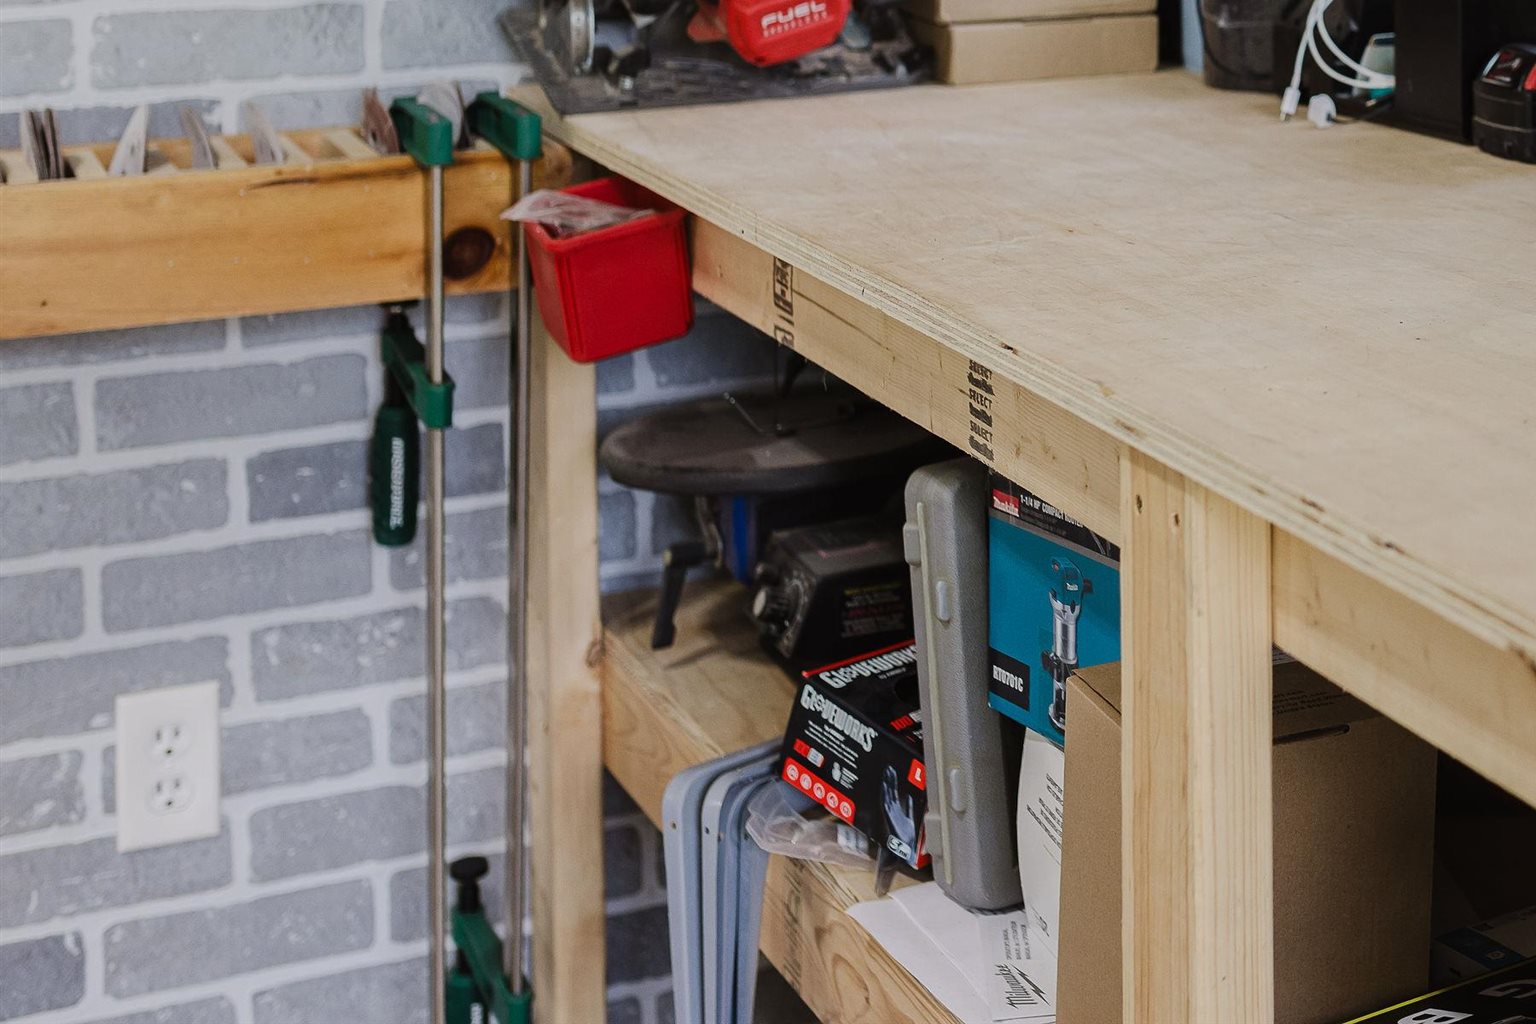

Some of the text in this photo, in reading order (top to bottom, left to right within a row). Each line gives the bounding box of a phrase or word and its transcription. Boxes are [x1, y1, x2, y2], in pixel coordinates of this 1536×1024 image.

[761, 0, 827, 29] FUEL
[800, 684, 876, 752] GLOVEWORKS
[995, 963, 1038, 1009] Milwaukee
